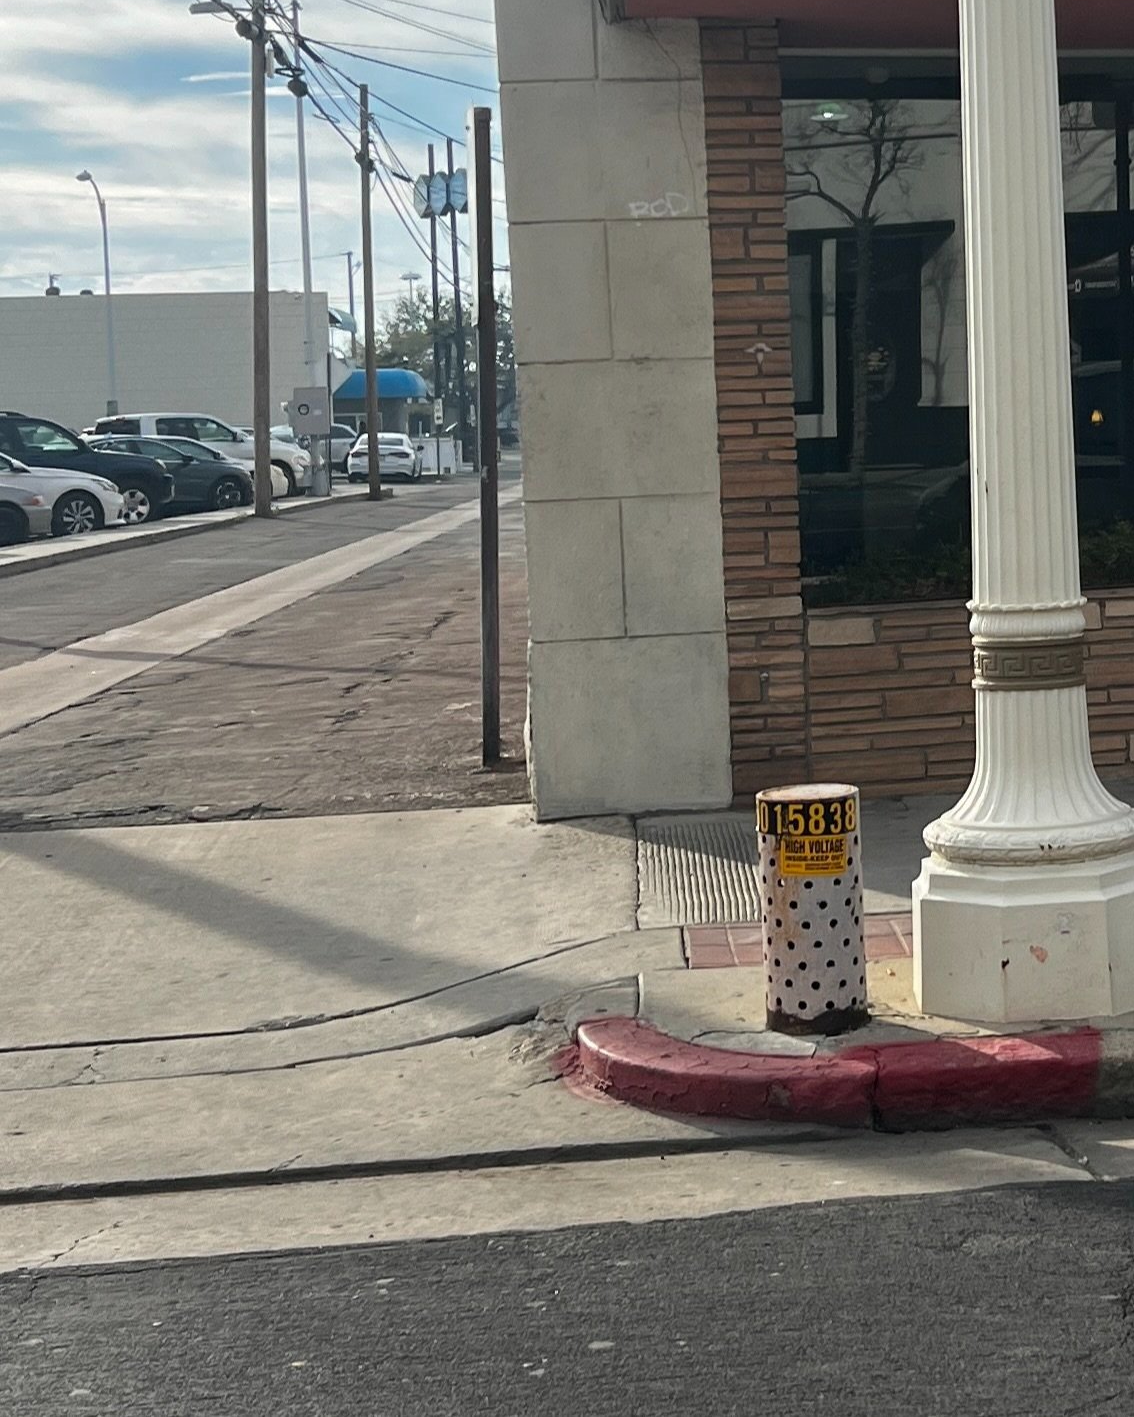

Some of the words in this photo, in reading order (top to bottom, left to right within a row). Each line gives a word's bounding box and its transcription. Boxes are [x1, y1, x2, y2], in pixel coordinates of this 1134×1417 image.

[760, 798, 855, 835] 015838
[785, 839, 806, 854] HIGH
[809, 838, 844, 854] VOLTAGE
